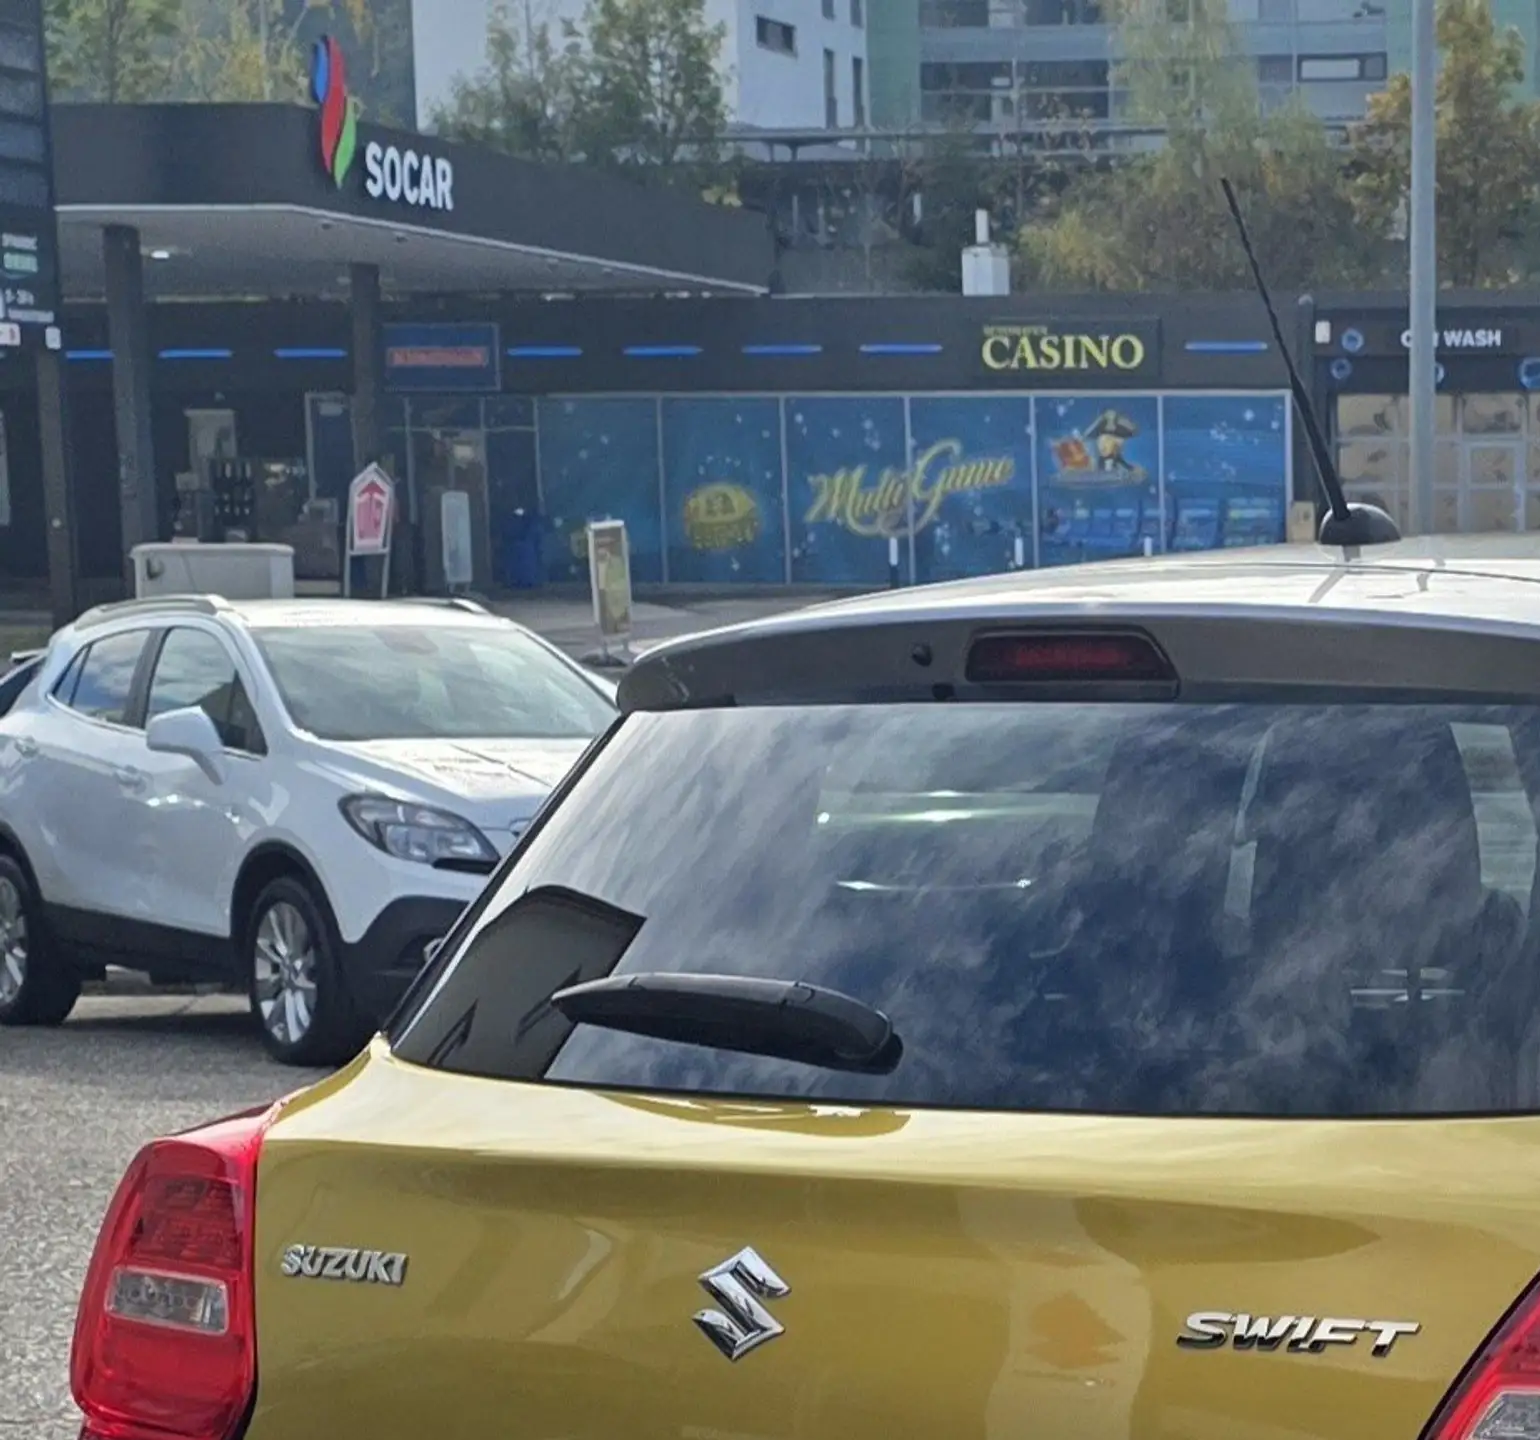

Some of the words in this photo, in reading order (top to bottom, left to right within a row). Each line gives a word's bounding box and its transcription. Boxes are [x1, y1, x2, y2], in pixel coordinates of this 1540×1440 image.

[365, 141, 454, 211] SOCAR
[981, 333, 1145, 370] CASINO
[1443, 329, 1502, 347] WASH
[281, 1243, 409, 1287] SUZUKI
[1176, 1310, 1422, 1358] SWIFT
